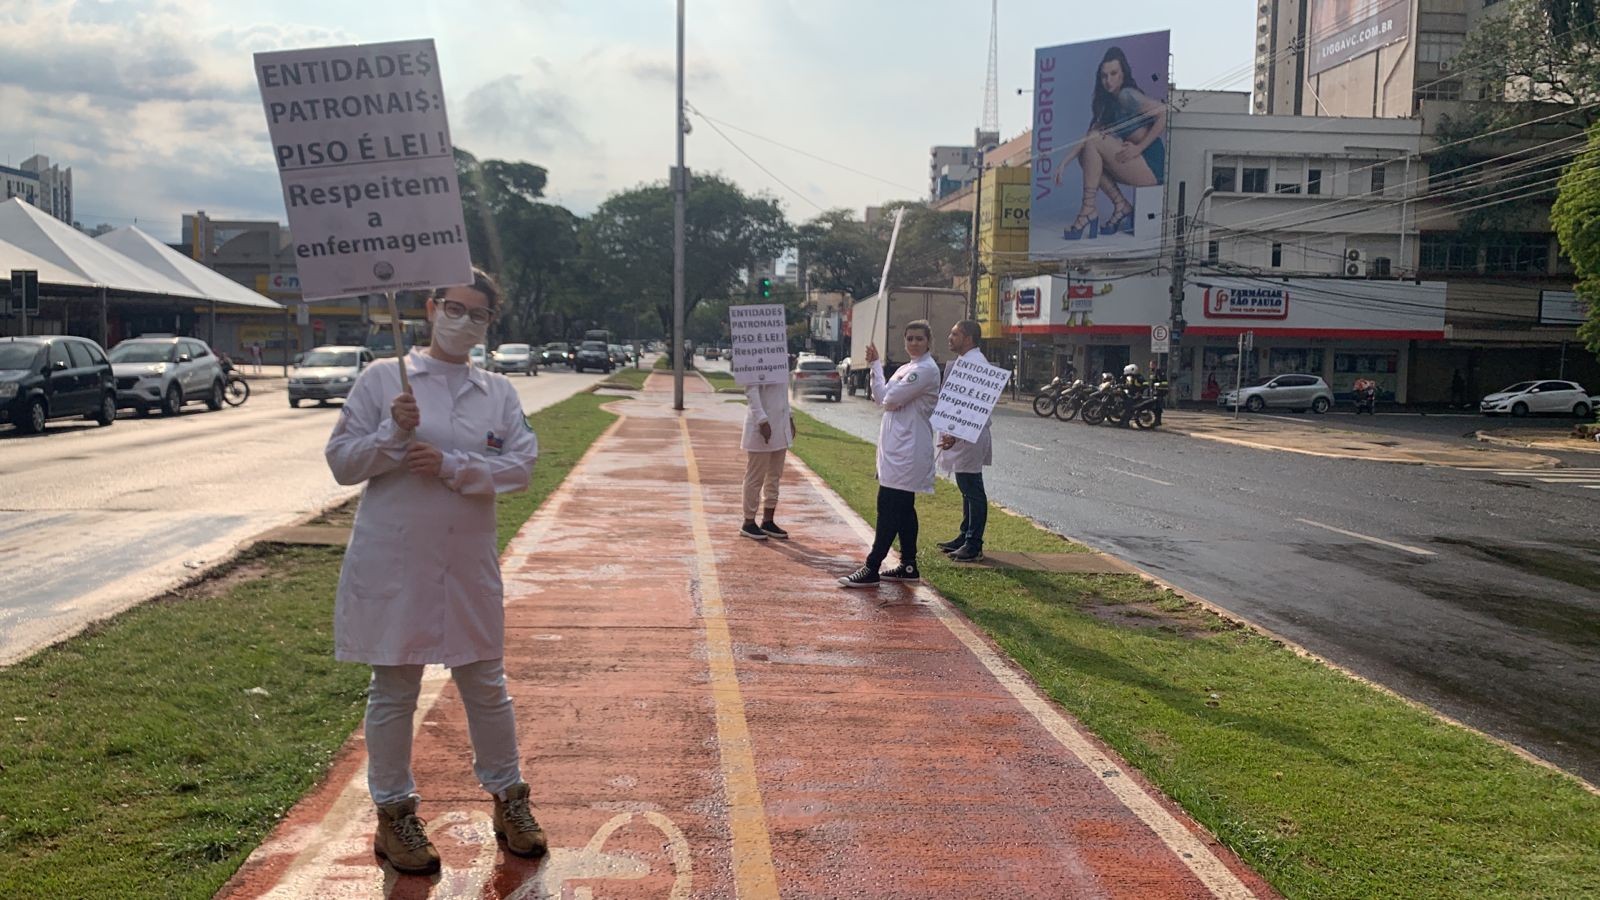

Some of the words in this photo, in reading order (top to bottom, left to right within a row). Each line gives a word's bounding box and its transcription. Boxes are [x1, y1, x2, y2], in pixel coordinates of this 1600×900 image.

[1322, 19, 1393, 58] LIGGAVC.COM.BR
[262, 51, 432, 88] ENTIDADE$
[270, 88, 440, 124] PATRONAI$:
[276, 140, 348, 167] PISO
[358, 133, 376, 160] É
[288, 175, 450, 208] Respeitem
[367, 211, 382, 228] a
[296, 224, 463, 259] enfermagem!
[1230, 297, 1249, 306] SÃO
[1251, 298, 1282, 307] PAULO
[732, 334, 754, 343] PISO
[757, 332, 763, 341] É
[734, 346, 785, 356] Respeitem
[734, 362, 787, 373] enfermagem!
[944, 381, 966, 394] PISO
[968, 388, 975, 396] É
[939, 392, 989, 415] Respeitem
